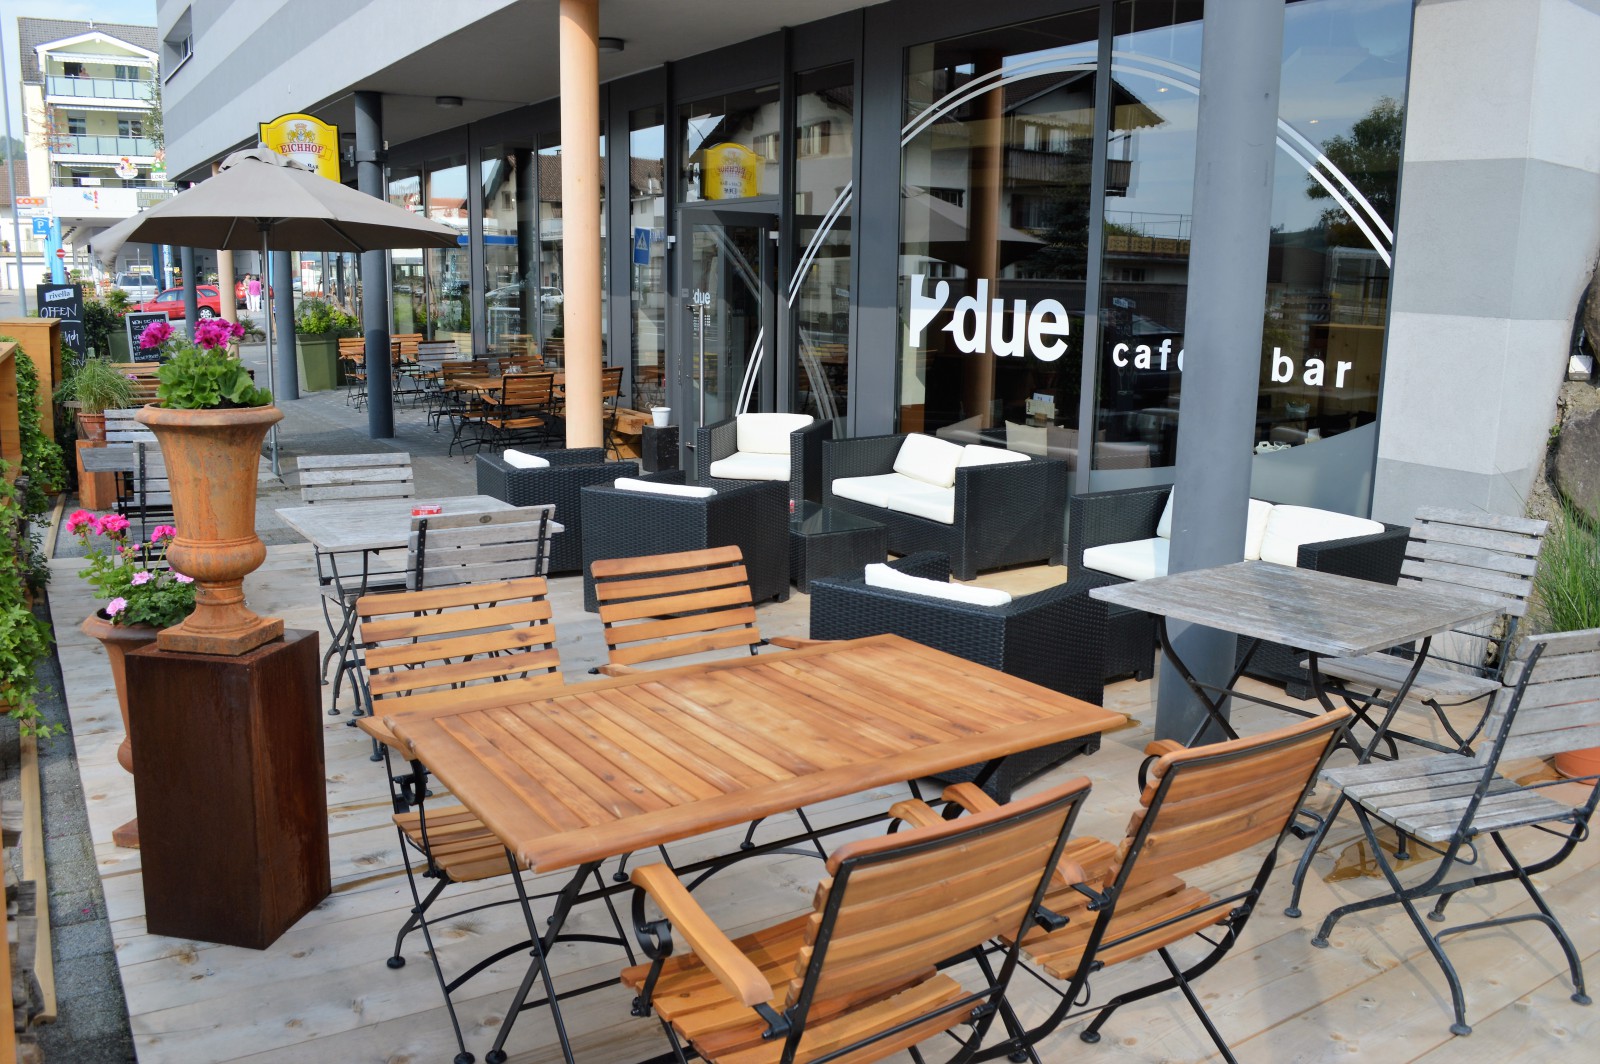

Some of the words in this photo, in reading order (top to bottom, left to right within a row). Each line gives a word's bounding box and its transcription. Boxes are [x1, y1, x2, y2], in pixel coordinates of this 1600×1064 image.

[280, 143, 324, 154] EICHHOF
[16, 197, 45, 207] coop
[49, 288, 71, 300] rivella
[40, 303, 77, 319] OFFEN
[1271, 346, 1352, 388] bar
